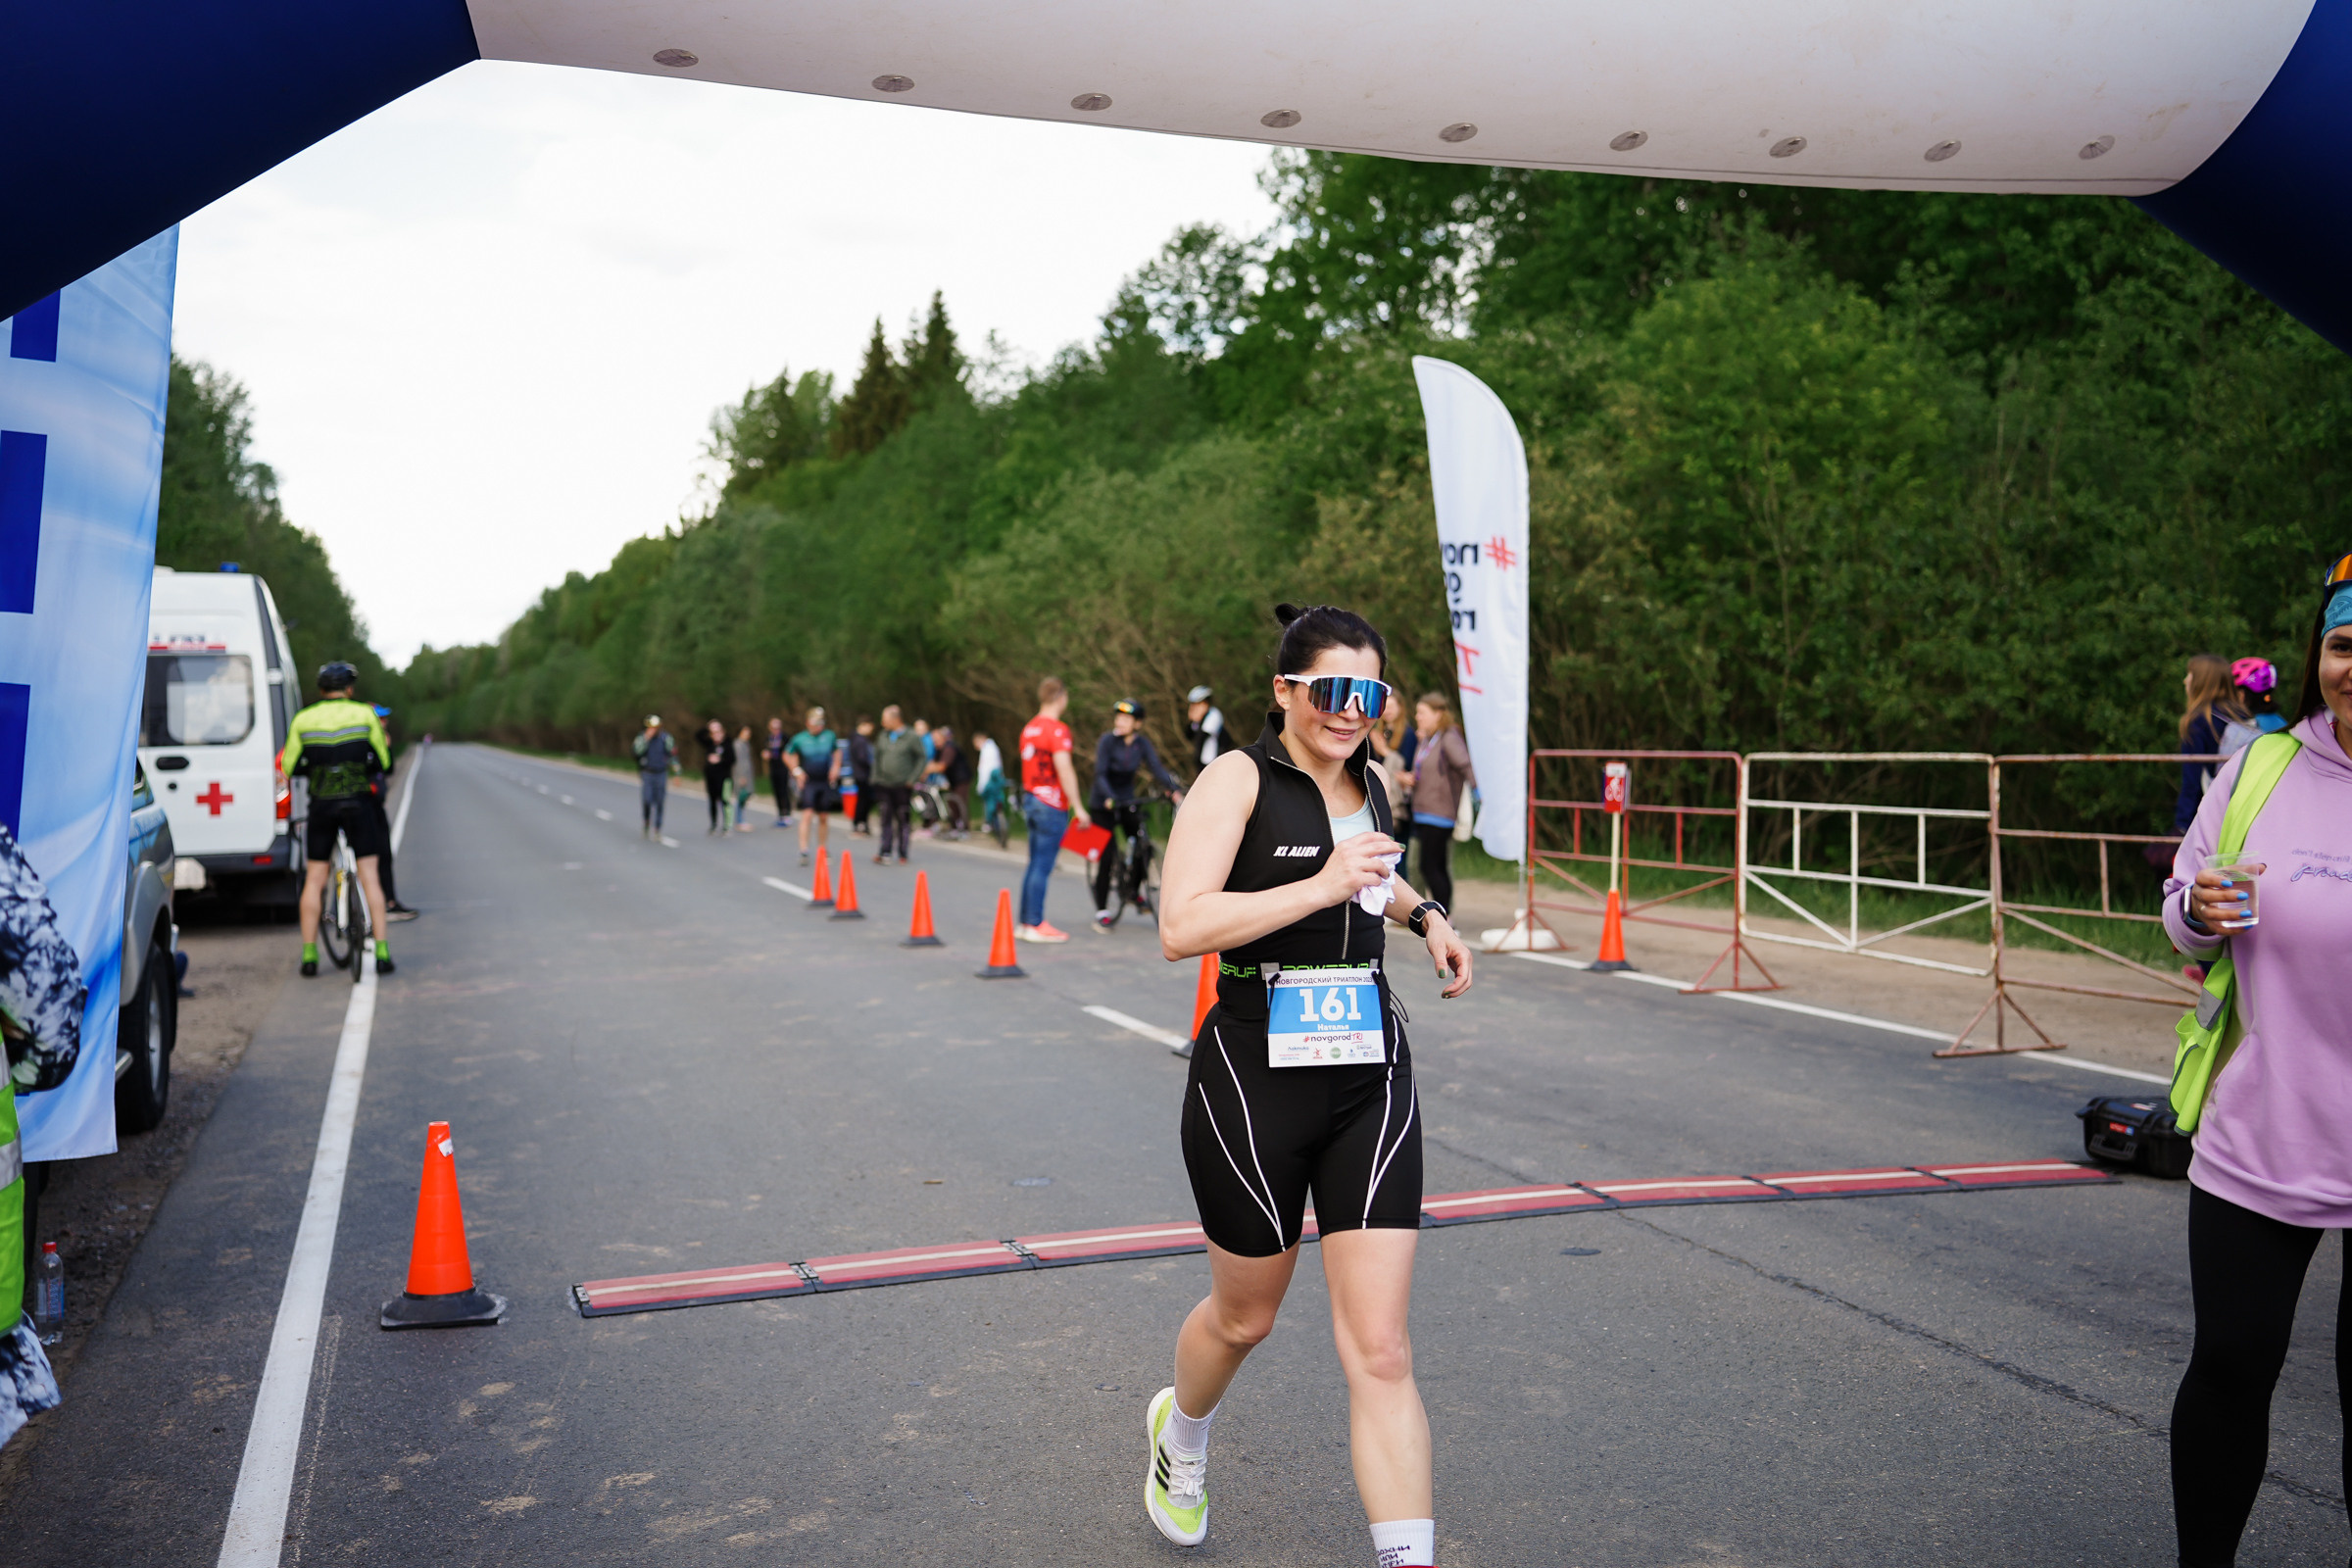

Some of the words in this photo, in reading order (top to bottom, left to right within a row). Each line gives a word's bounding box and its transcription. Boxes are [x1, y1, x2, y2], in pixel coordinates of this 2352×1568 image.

[1287, 846, 1321, 858] ALIEN
[1276, 975, 1332, 985] НОВГОРОДСКИЙ
[1298, 987, 1362, 1023] 161
